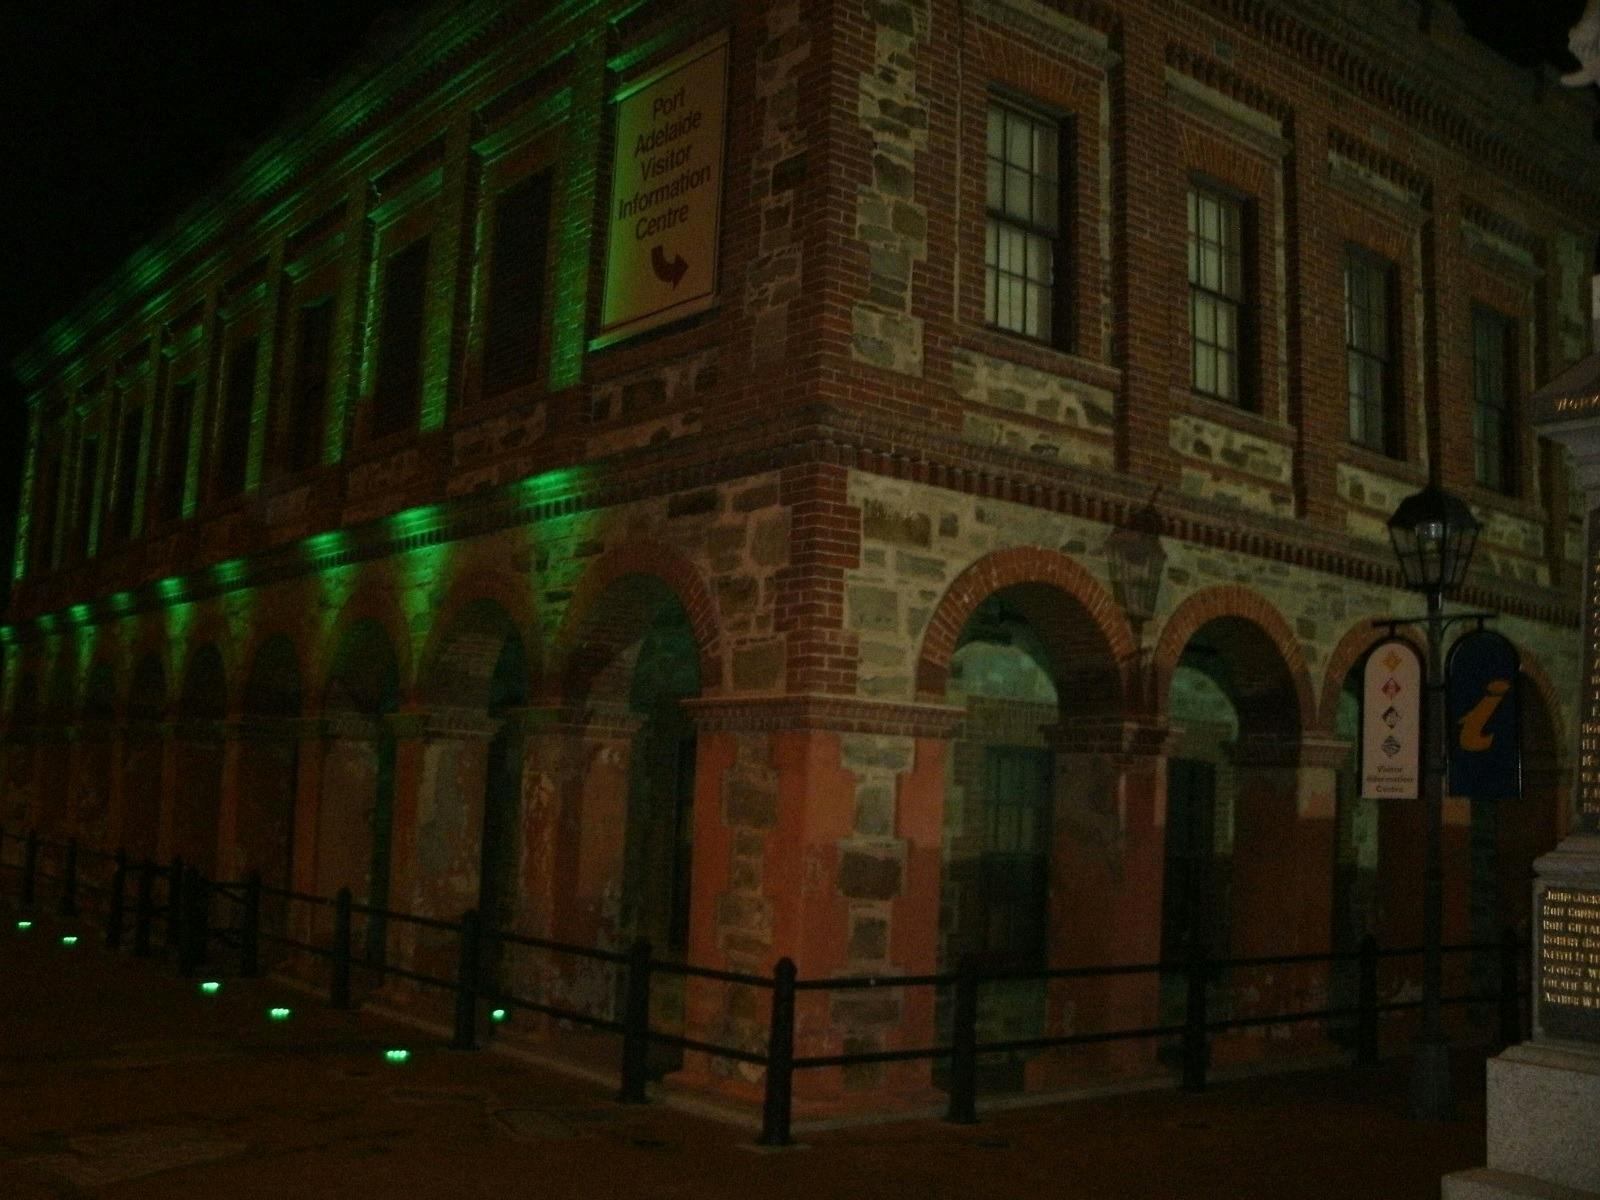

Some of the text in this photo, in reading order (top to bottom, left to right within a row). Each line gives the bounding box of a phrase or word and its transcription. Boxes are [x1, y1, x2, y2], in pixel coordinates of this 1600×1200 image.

[653, 86, 685, 120] Port
[634, 110, 702, 158] Adelaide
[641, 144, 692, 181] Visitor
[619, 165, 711, 221] Information
[635, 204, 689, 240] Centre
